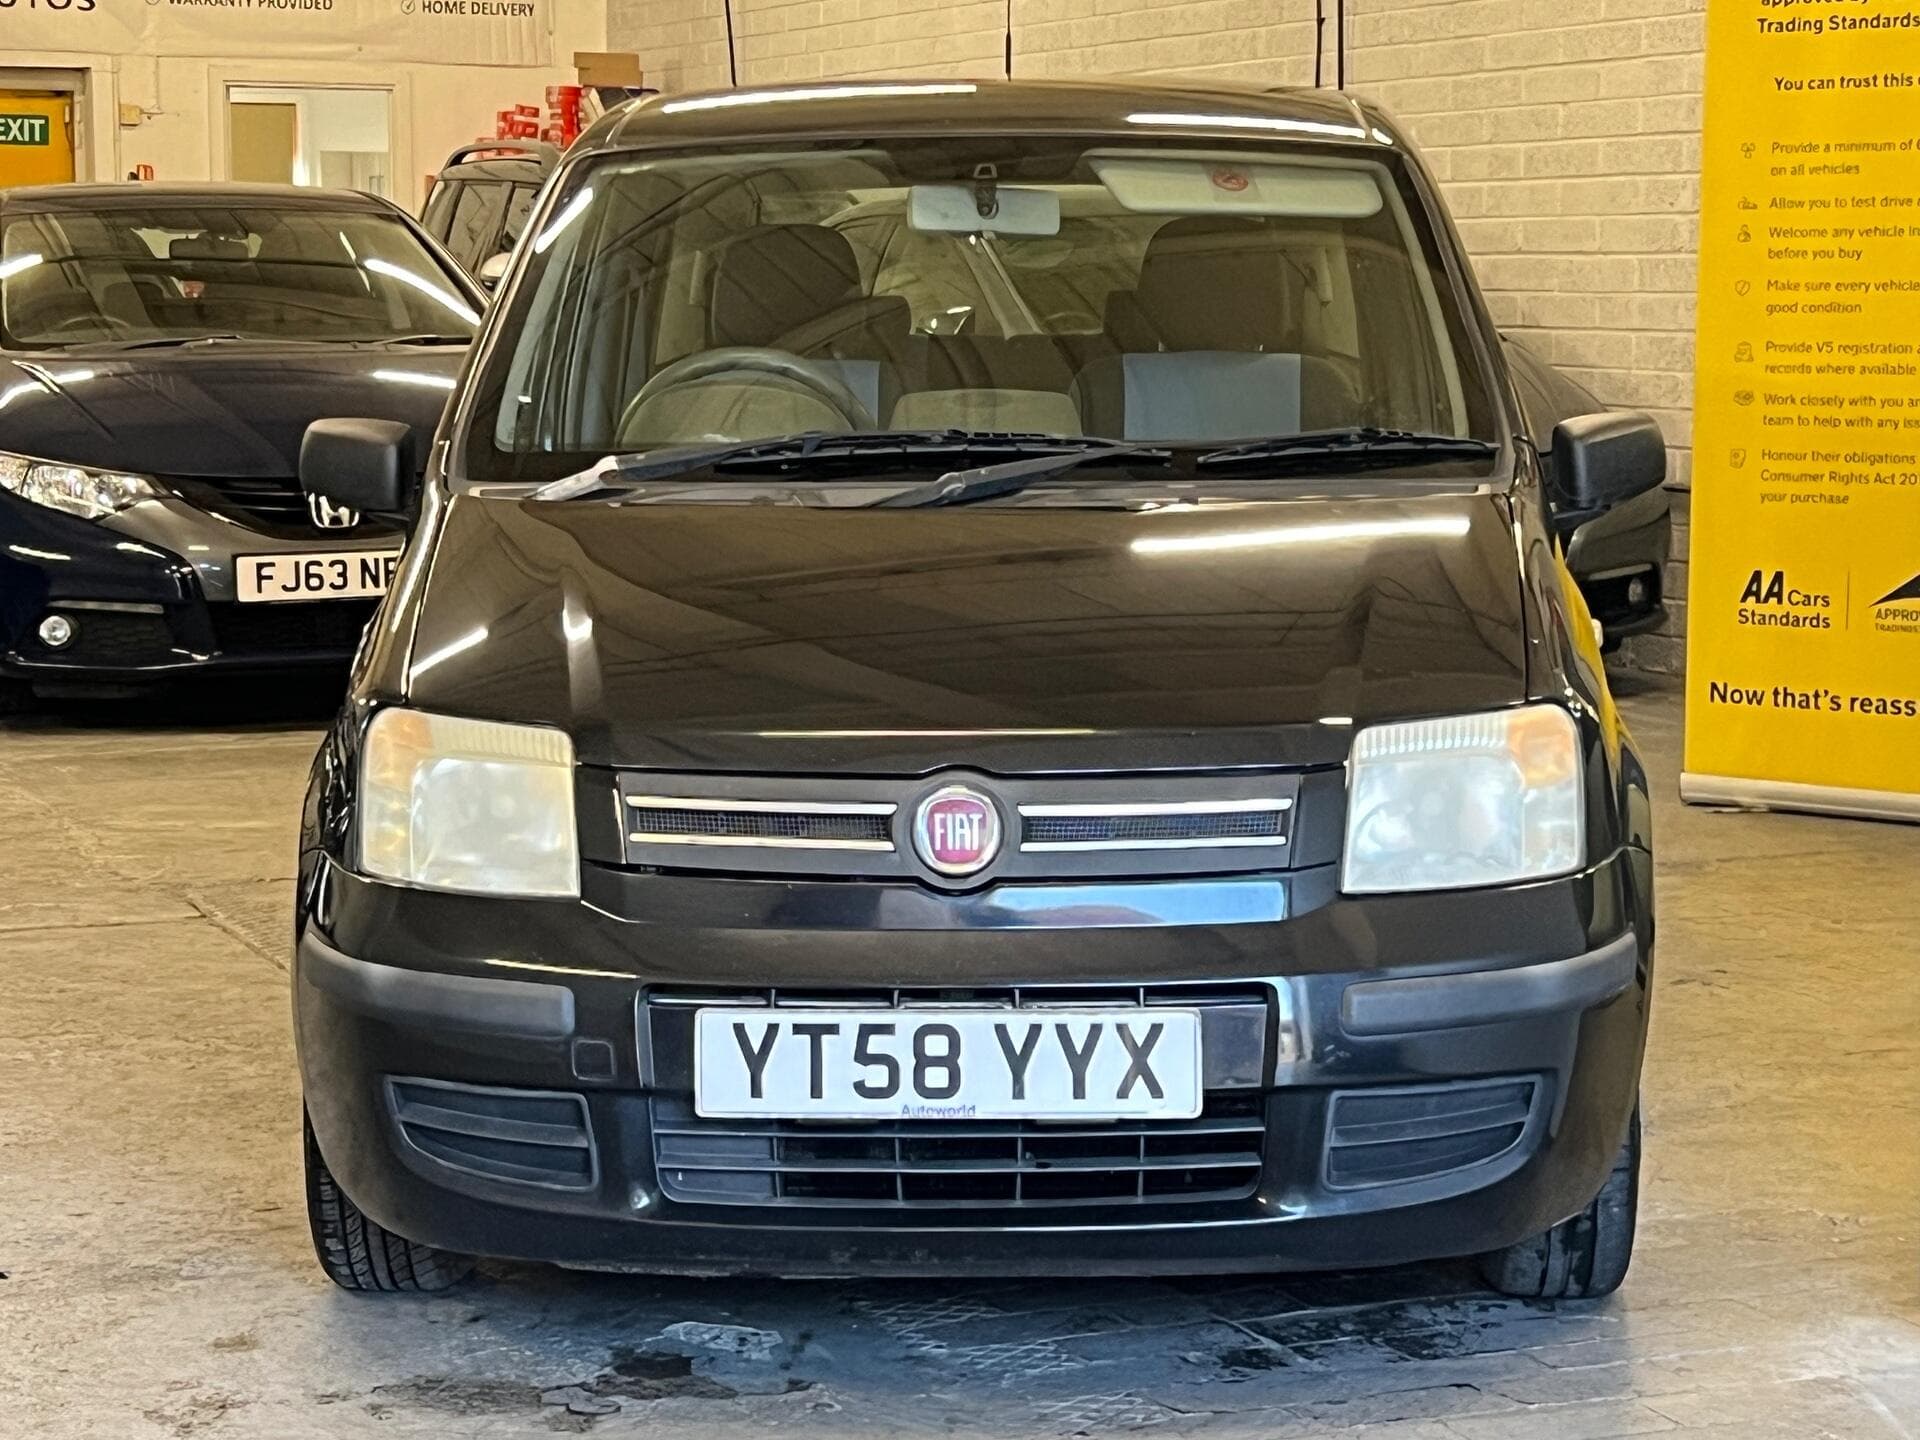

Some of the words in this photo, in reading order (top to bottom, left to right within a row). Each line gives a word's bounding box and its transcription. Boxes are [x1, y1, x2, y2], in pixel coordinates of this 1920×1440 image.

[258, 0, 333, 10] PROVIDED
[422, 0, 466, 14] HOME
[471, 2, 535, 16] DELIVERY
[1757, 17, 1823, 34] Trading
[1829, 12, 1920, 30] Standards
[1774, 77, 1803, 91] You
[1808, 78, 1835, 90] can
[1840, 74, 1878, 89] trust
[1883, 73, 1913, 87] this
[0, 118, 46, 142] EXIT
[1771, 142, 1820, 153] Provide
[1824, 143, 1830, 153] a
[1835, 142, 1896, 152] minimum
[1899, 139, 1913, 150] of
[1770, 167, 1786, 176] on
[1791, 164, 1805, 175] all
[1808, 163, 1860, 175] vehicles
[1769, 197, 1805, 209] Allow
[1809, 199, 1831, 211] you
[1834, 197, 1848, 208] to
[1851, 196, 1877, 208] test
[1880, 196, 1913, 207] drive
[1769, 227, 1828, 239] Welcome
[1832, 228, 1855, 240] any
[1858, 226, 1905, 237] vehicle
[1768, 248, 1808, 259] before
[1812, 249, 1834, 260] you
[1838, 247, 1863, 261] buy
[1766, 280, 1801, 292] Make
[1804, 281, 1832, 292] sure
[1835, 281, 1871, 293] every
[1874, 280, 1920, 292] vehicle
[1765, 302, 1799, 316] good
[1801, 302, 1862, 313] condition
[1765, 340, 1813, 353] Provide
[1816, 341, 1834, 353] V5
[1837, 341, 1913, 356] registration
[1764, 363, 1812, 375] records
[1815, 363, 1856, 375] where
[1859, 362, 1917, 375] available
[1764, 393, 1796, 406] Work
[1800, 394, 1845, 409] closely
[1848, 395, 1877, 407] with
[1880, 398, 1904, 409] you
[1762, 415, 1794, 426] team
[1797, 415, 1810, 427] to
[1813, 415, 1841, 428] help
[1845, 416, 1873, 428] with
[1877, 418, 1900, 430] any
[1761, 449, 1808, 461] Honour
[1811, 450, 1841, 462] their
[1844, 452, 1916, 466] obligations
[1760, 469, 1826, 482] Consumer
[1828, 471, 1870, 486] Rights
[1873, 472, 1896, 485] Act
[1760, 492, 1787, 503] your
[1790, 493, 1850, 504] purchase
[256, 559, 349, 594] FJ63
[1740, 570, 1784, 605] AA
[1787, 589, 1830, 608] Cars
[1738, 608, 1831, 629] Standards
[1875, 608, 1920, 621] APPRO
[1710, 681, 1765, 706] Now
[1772, 686, 1842, 712] that's
[1850, 696, 1917, 716] reass
[933, 813, 983, 851] FIAT
[732, 1023, 962, 1100] YT58
[995, 1023, 1164, 1100] YYX
[901, 1104, 976, 1117] Autoworld
